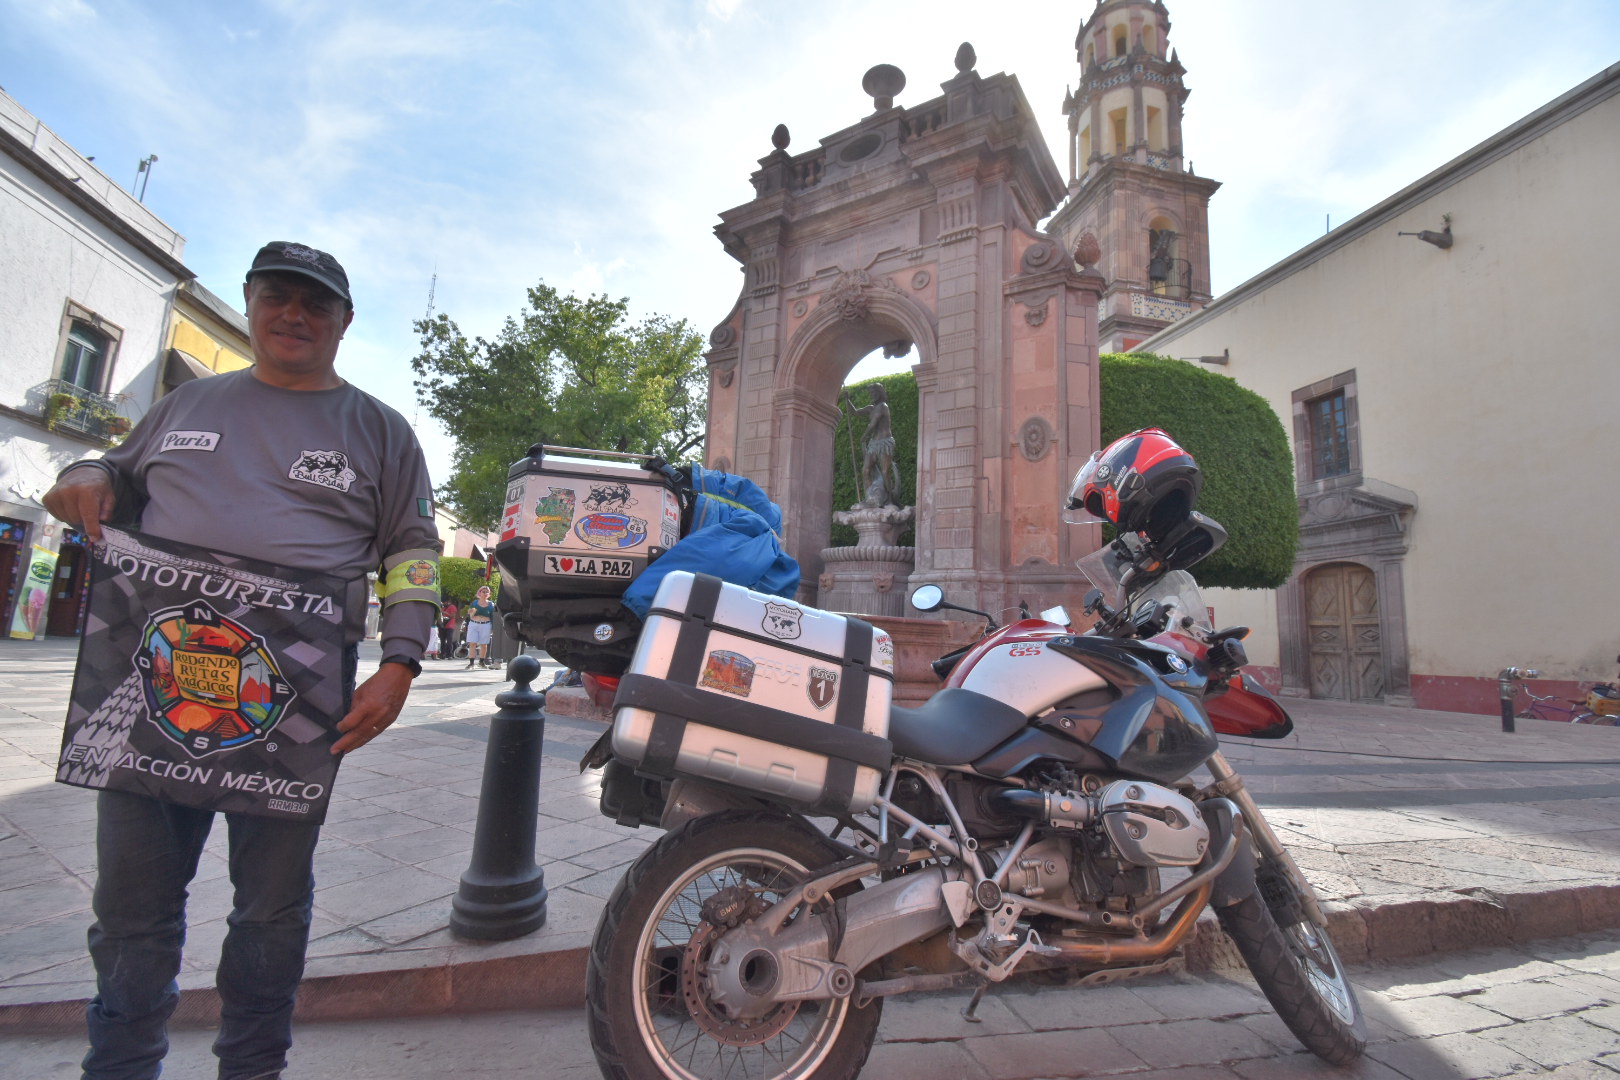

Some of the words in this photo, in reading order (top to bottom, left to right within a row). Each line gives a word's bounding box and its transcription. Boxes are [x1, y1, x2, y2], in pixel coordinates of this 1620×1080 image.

[165, 433, 211, 447] Paris
[293, 470, 317, 482] Bull
[630, 524, 641, 532] 66
[575, 559, 597, 574] LA
[600, 560, 631, 577] PAZ
[194, 608, 212, 621] N
[1009, 646, 1041, 657] GS
[276, 683, 289, 694] E
[816, 679, 826, 701] 1
[193, 737, 209, 749] S
[67, 744, 109, 765] EN
[114, 752, 213, 785] ACCIÓN
[219, 771, 324, 800] MÉXICO
[720, 902, 738, 916] BMW
